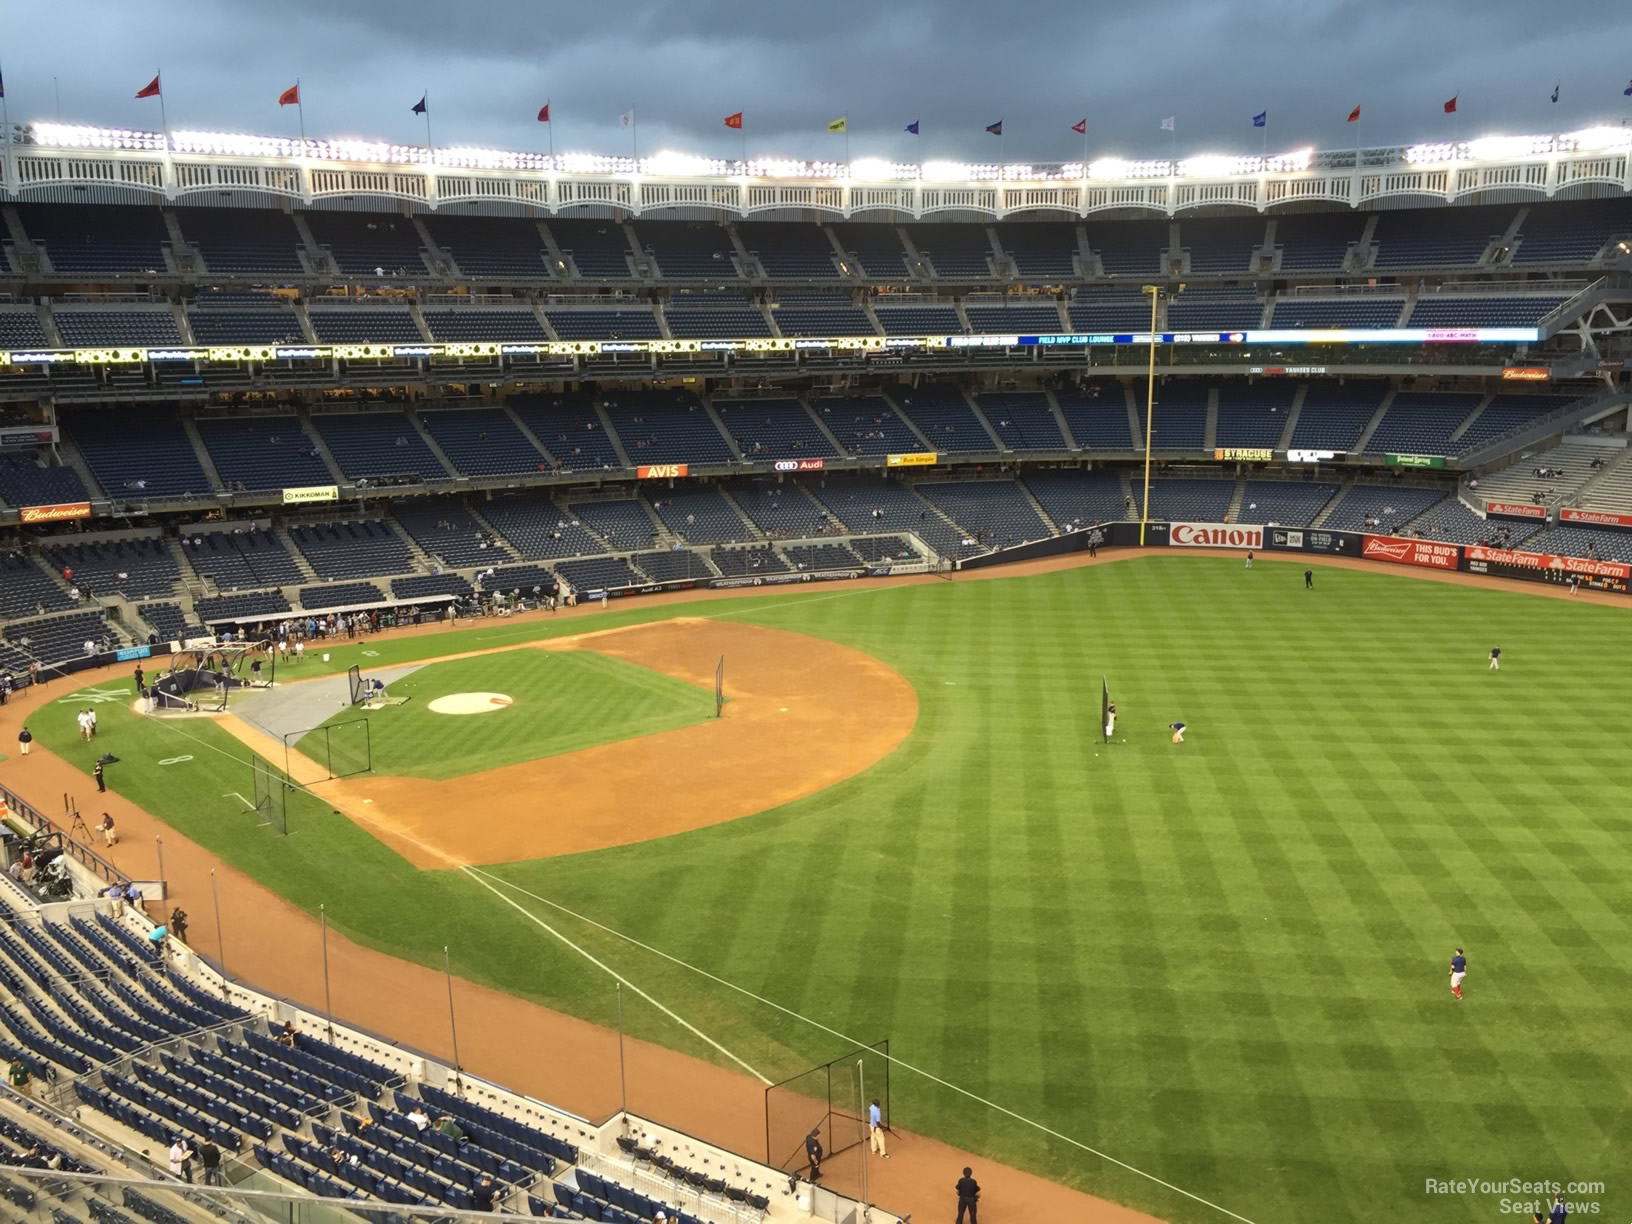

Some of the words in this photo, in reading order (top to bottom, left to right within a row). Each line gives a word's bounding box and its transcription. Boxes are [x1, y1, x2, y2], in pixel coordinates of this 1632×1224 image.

[1502, 369, 1548, 379] Budweiser
[1224, 449, 1272, 458] SYRACUSE
[800, 460, 823, 469] Audi
[647, 466, 679, 478] AVIS
[294, 491, 330, 499] KIKKOMAN
[21, 507, 90, 521] Budweiser
[1172, 525, 1262, 546] Canon
[1369, 542, 1406, 554] Budweiser
[1415, 543, 1433, 554] THIS
[1434, 546, 1457, 557] BUD'S
[1414, 553, 1430, 563] FOR
[1431, 555, 1449, 565] YOU.
